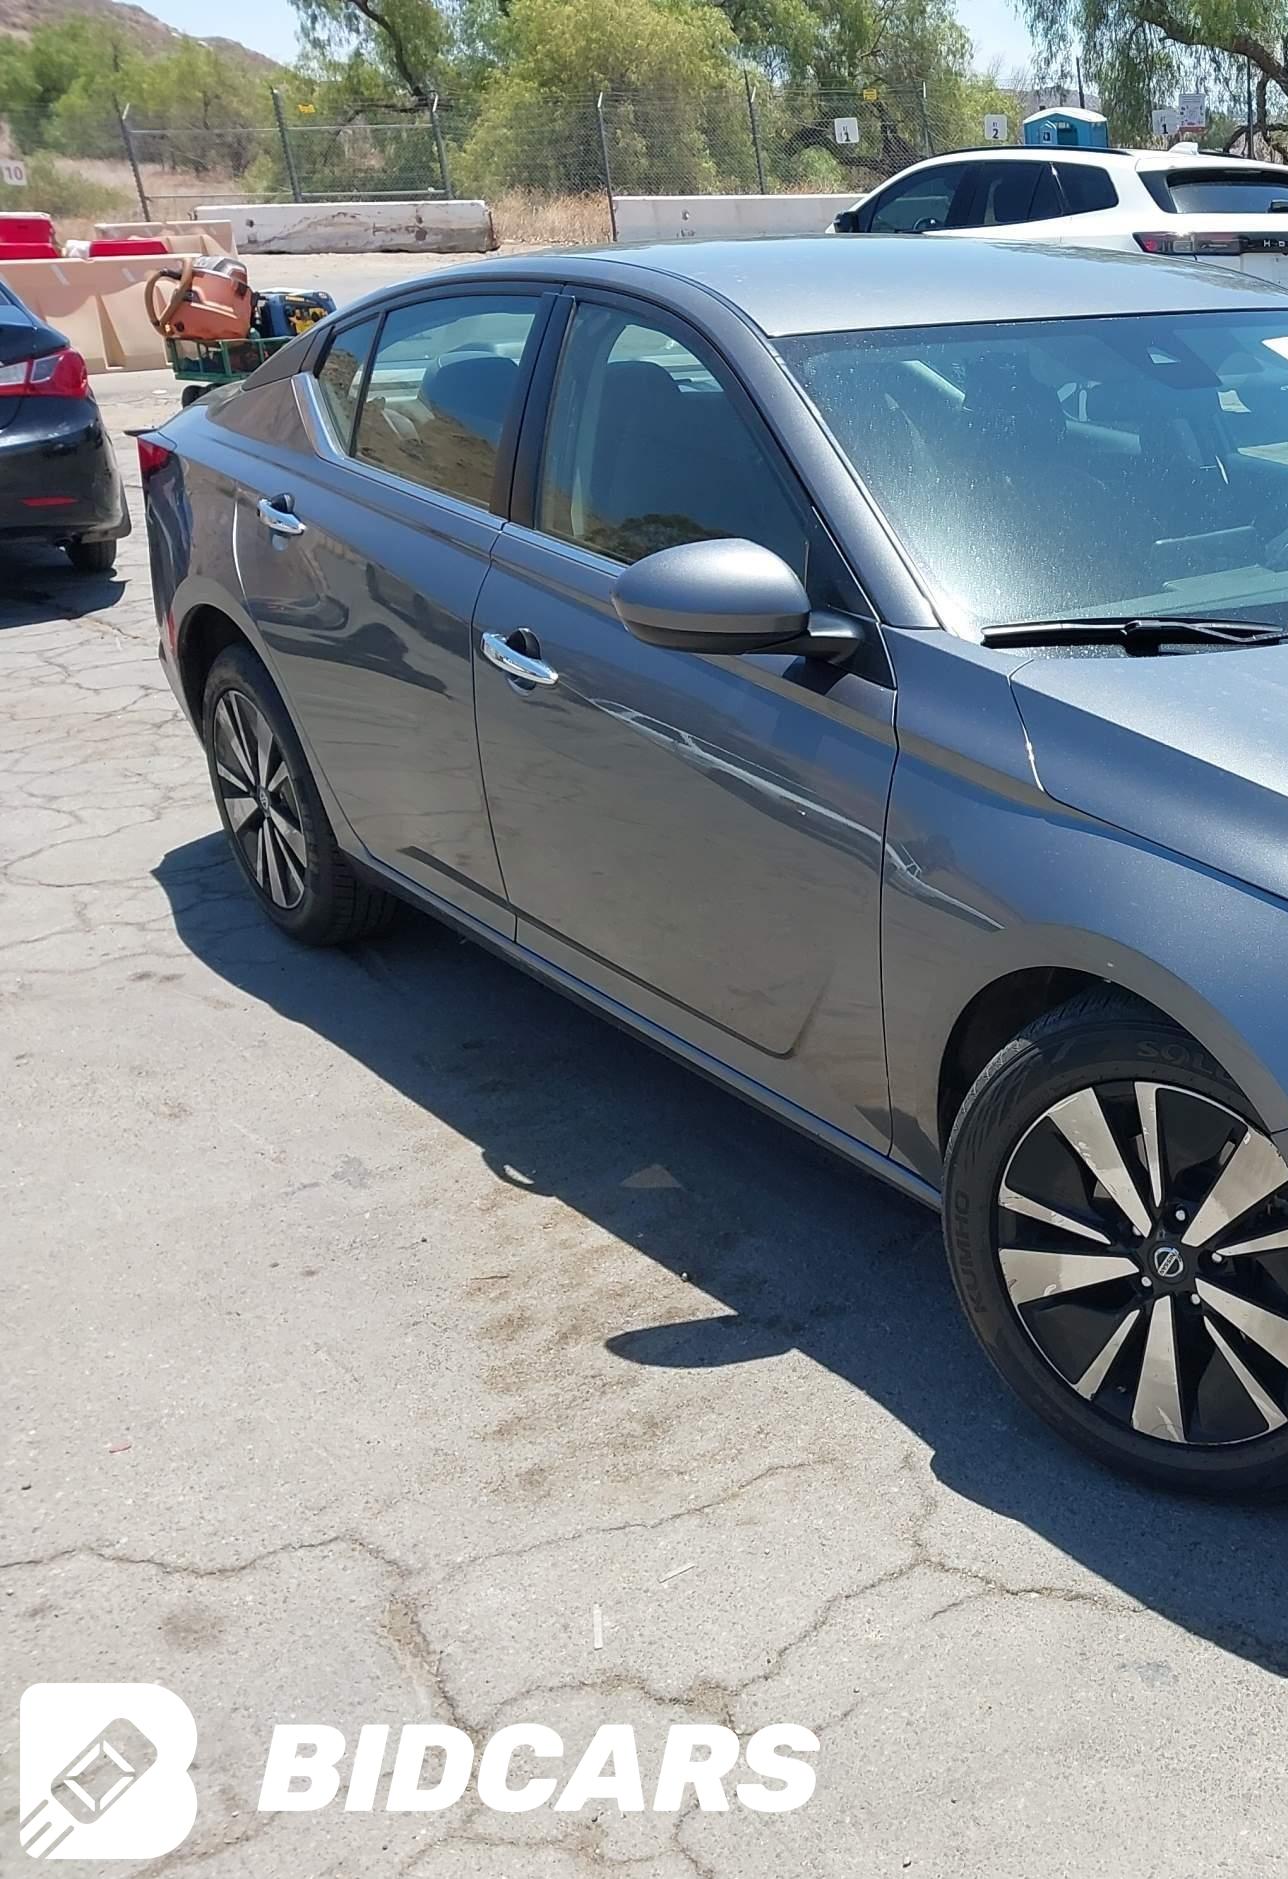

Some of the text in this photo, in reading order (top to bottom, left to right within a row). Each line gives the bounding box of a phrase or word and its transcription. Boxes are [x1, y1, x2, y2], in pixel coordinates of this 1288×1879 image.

[992, 128, 999, 139] 2
[1162, 123, 1168, 134] 1
[5, 166, 23, 180] 10
[955, 1189, 988, 1313] KUMHO
